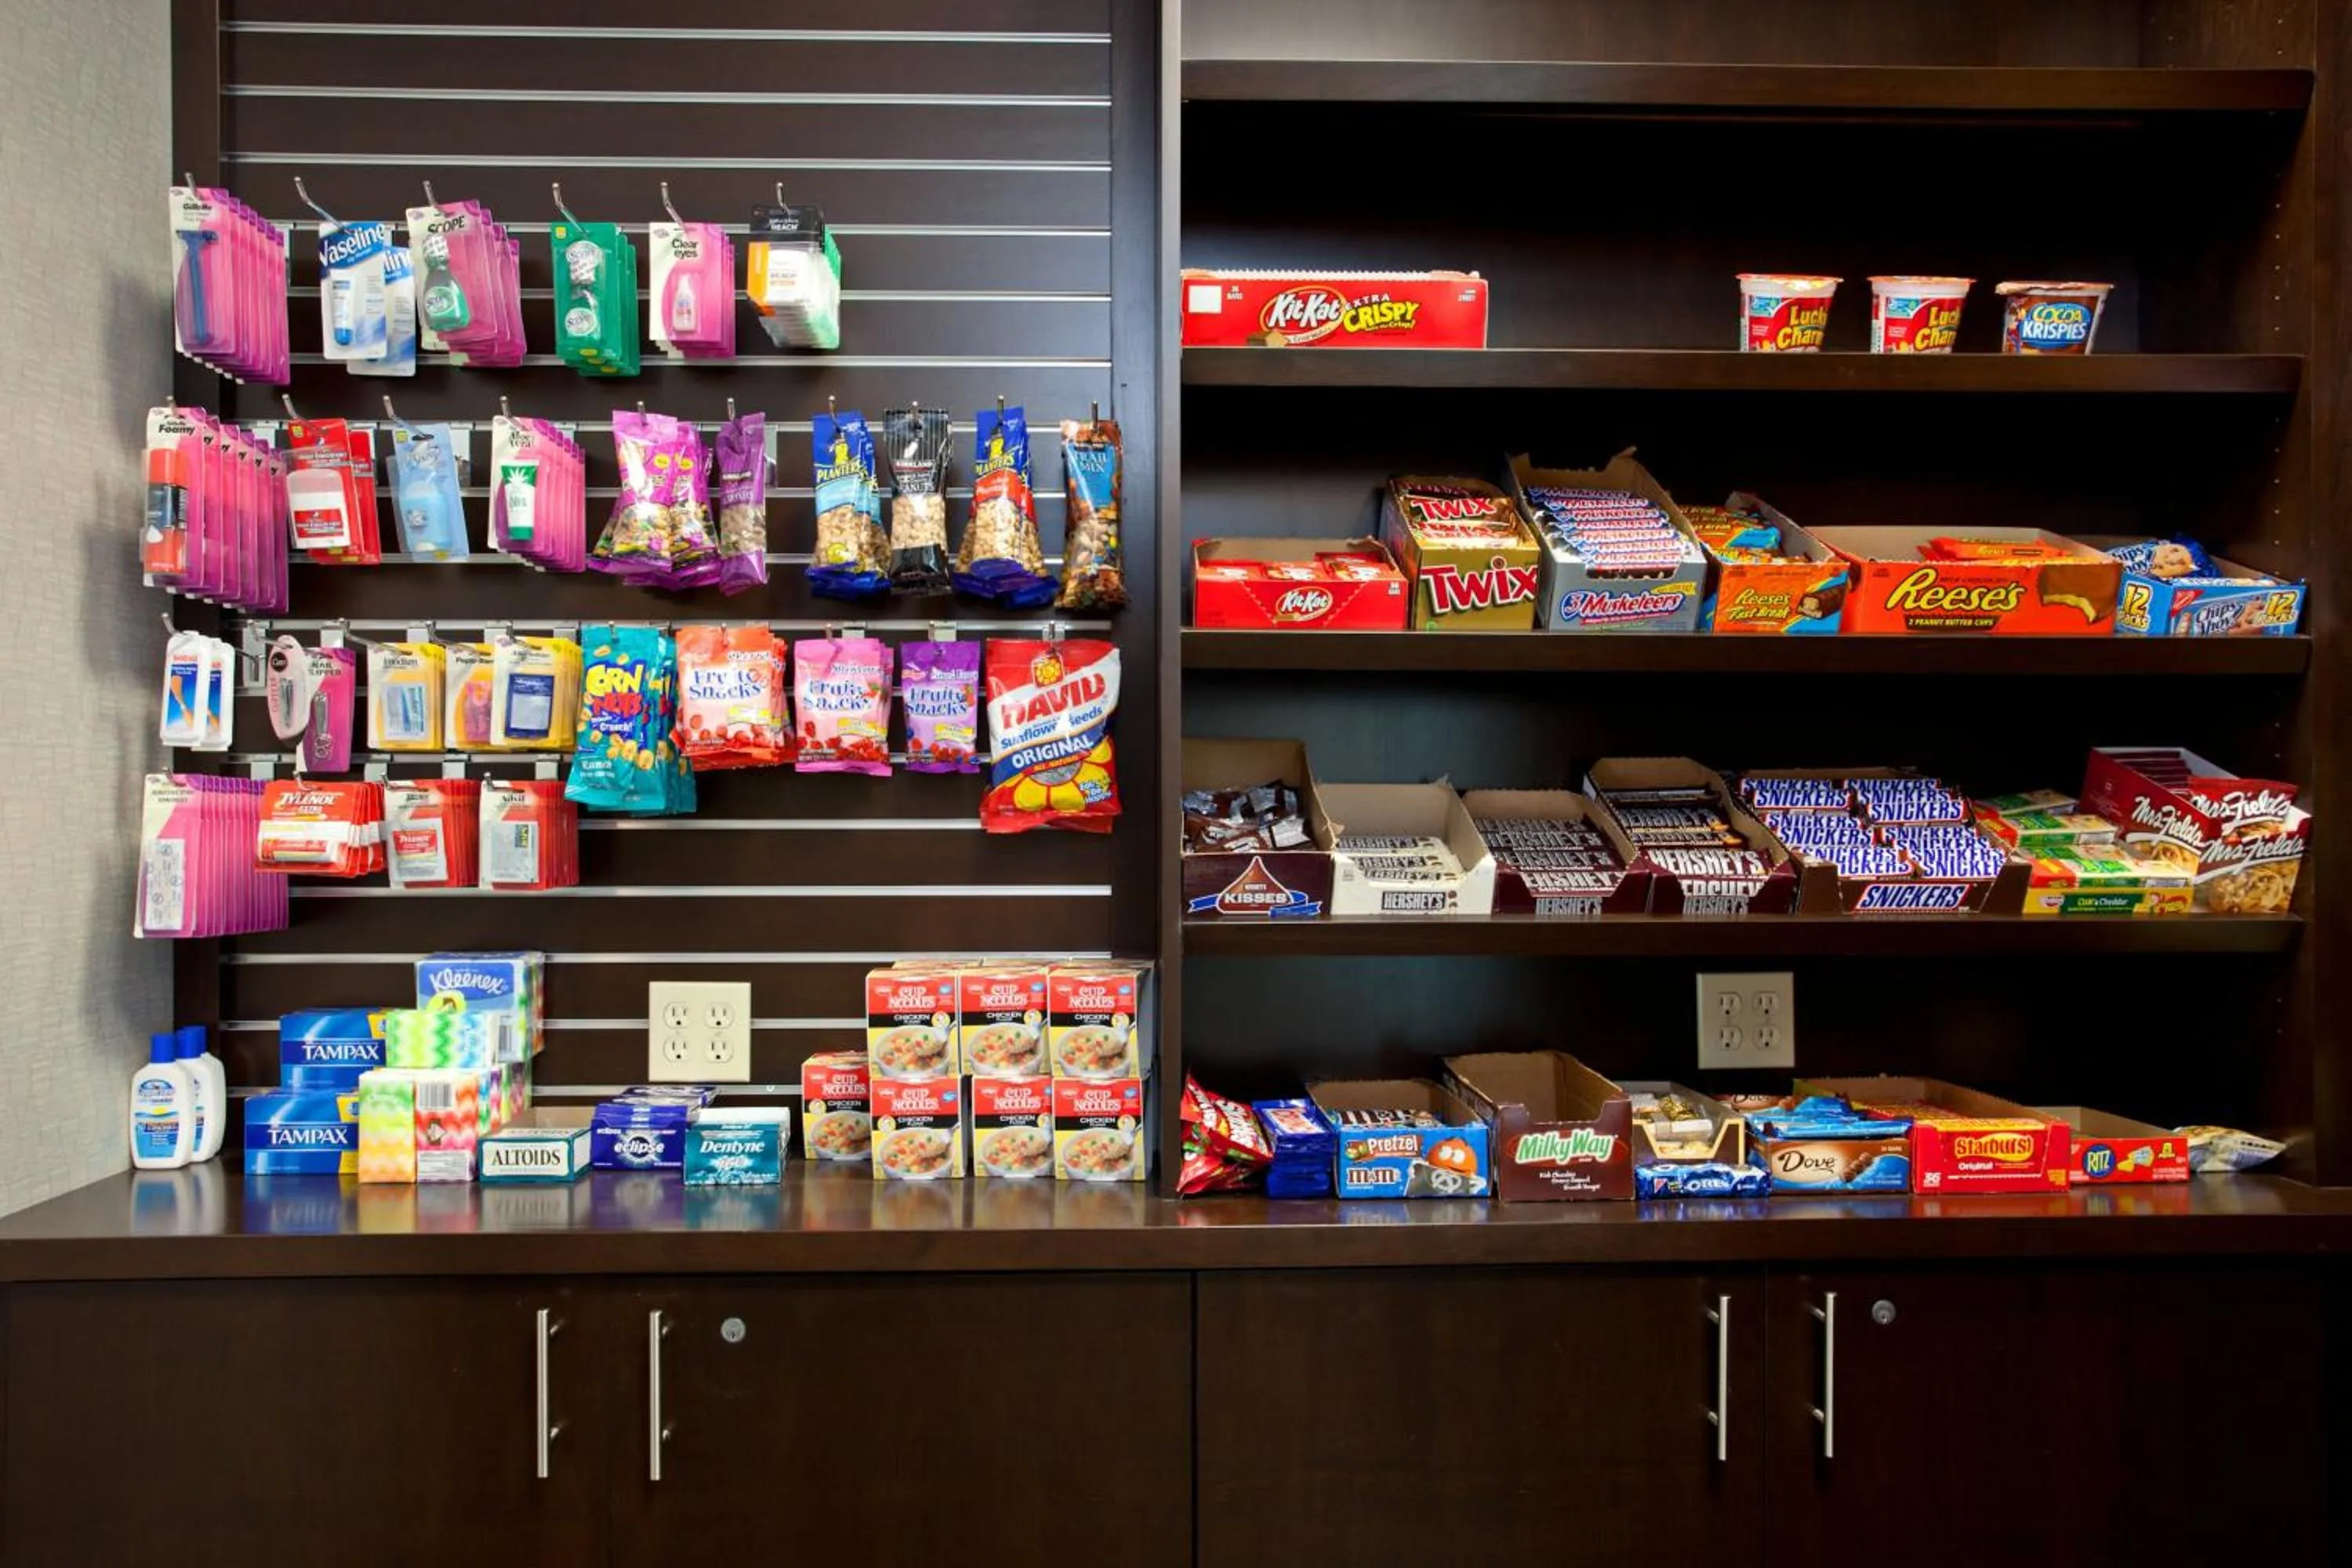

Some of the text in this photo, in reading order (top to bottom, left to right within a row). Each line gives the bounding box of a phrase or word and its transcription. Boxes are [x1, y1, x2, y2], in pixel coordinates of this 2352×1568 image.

[427, 215, 466, 234] SCOPE
[319, 223, 387, 267] Vaseline
[671, 238, 699, 250] Clear
[673, 249, 699, 259] eyes
[1345, 293, 1391, 310] EXTRA
[1343, 300, 1421, 333] CRISPY
[1789, 306, 1827, 326] Luck
[2032, 304, 2082, 323] COCOA
[2021, 321, 2087, 340] KRISPIES
[158, 424, 195, 436] Foamy
[2112, 546, 2144, 563] hips
[1885, 567, 2027, 612] Reese's
[1581, 592, 1683, 617] Musketeers
[2122, 586, 2153, 615] 12
[2265, 591, 2298, 615] 12
[1729, 605, 1792, 620] Fast Break
[2196, 601, 2239, 624] Chips
[1915, 618, 1944, 626] PEANUT
[1946, 617, 1973, 626] BUTTER
[1975, 618, 1994, 626] CUPS
[586, 664, 644, 697] CORN
[689, 684, 761, 700] Snacks
[1002, 672, 1106, 729] DAVID
[592, 691, 642, 717] NUTS
[804, 695, 872, 710] Snacks
[904, 702, 967, 716] Snacks
[1069, 705, 1103, 728] seeds
[1012, 734, 1094, 769] ORIGINAL
[1756, 790, 1849, 808] SNICKERS
[1860, 789, 1951, 804] SNICKERS
[2223, 789, 2292, 819] Fields
[1871, 802, 1962, 822] SNICKERS
[1768, 814, 1860, 829] SNICKERS
[2161, 805, 2206, 848] Fields
[1779, 828, 1873, 845] SNICKERS
[2244, 831, 2306, 862] Fields
[1648, 849, 1766, 876] HERSHEY'S
[1838, 862, 1911, 876] ICKERS
[1521, 871, 1635, 887] ERSHEY'S
[1224, 892, 1287, 904] KISSES
[1381, 891, 1446, 910] HERSHEY'S
[1858, 885, 1965, 909] SNICKERS
[1535, 897, 1603, 916] HERSHEY'S
[1682, 897, 1750, 915] HERSHEY'S
[429, 967, 504, 994] Kleenex
[899, 985, 927, 996] CUP
[991, 984, 1018, 995] CUP
[1079, 986, 1106, 996] CUP
[887, 996, 935, 1009] NOODLES
[981, 994, 1028, 1007] NOODLES
[1069, 996, 1116, 1008] NOODLES
[300, 1044, 380, 1061] TAMPAX
[833, 1075, 858, 1085] CUP
[822, 1083, 866, 1095] NOODLES
[903, 1088, 929, 1098] CUP
[1005, 1087, 1032, 1098] CUP
[1084, 1090, 1111, 1100] CUP
[891, 1098, 939, 1111] NOODLES
[993, 1098, 1041, 1110] NOODLES
[1073, 1099, 1121, 1112] NOODLES
[267, 1128, 348, 1145] TAMPAX
[1367, 1135, 1418, 1153] Pretzel
[614, 1139, 665, 1154] eclipse
[699, 1140, 766, 1155] Dentyne
[1515, 1128, 1613, 1166] Milky Way
[1956, 1135, 2034, 1156] Starburst
[491, 1149, 562, 1167] ALTOIDS
[2085, 1149, 2111, 1173] RITZ
